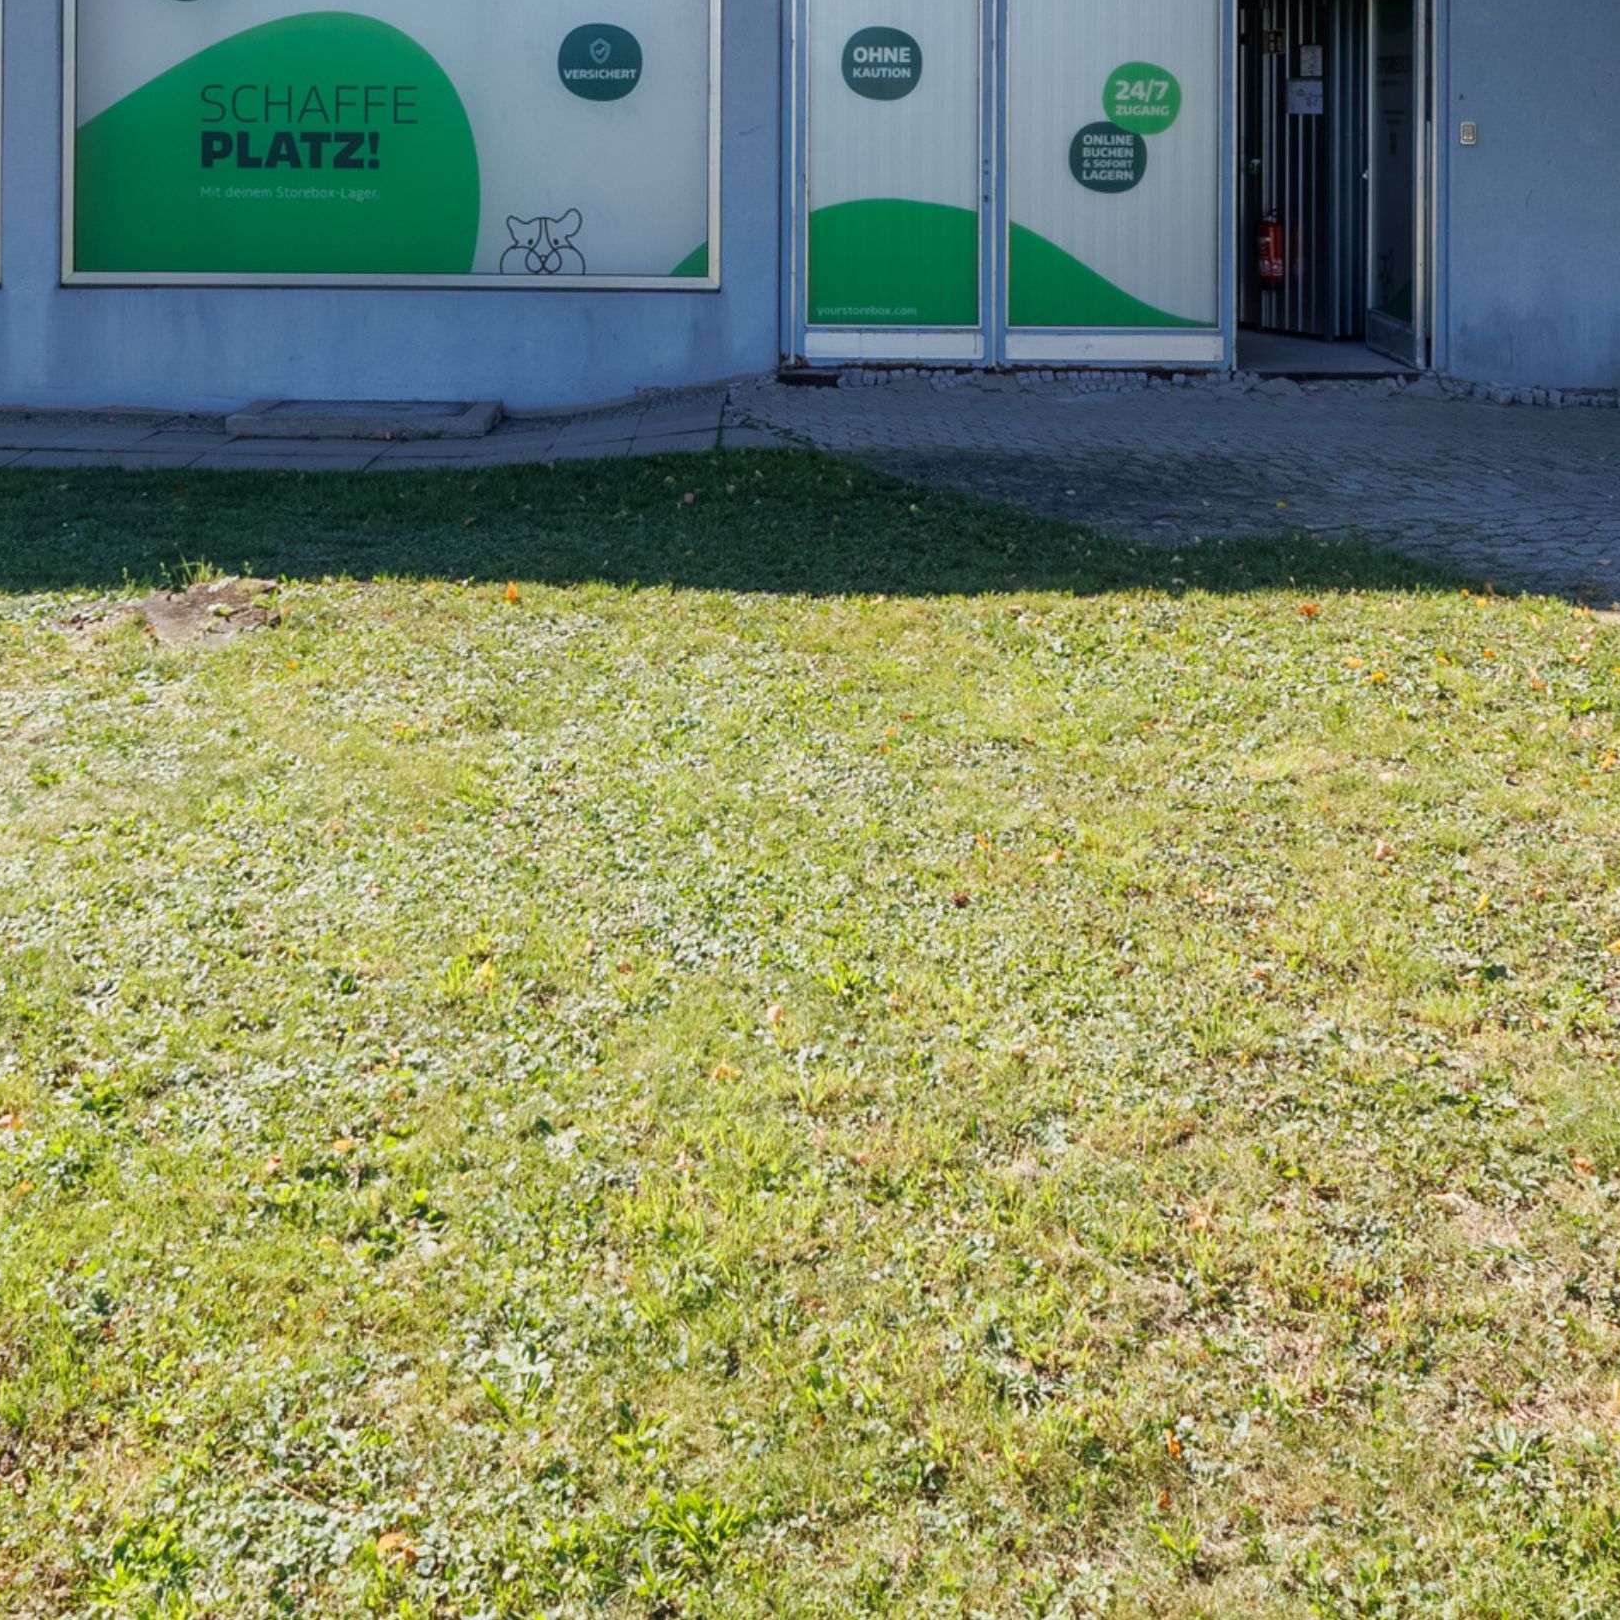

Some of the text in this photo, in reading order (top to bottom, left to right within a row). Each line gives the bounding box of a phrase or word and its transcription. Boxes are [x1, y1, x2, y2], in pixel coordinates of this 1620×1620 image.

[853, 47, 910, 62] OHNE
[564, 69, 637, 80] VERSICHERT
[853, 68, 910, 78] KAUTION
[1116, 79, 1168, 102] 24/7
[200, 85, 417, 124] SCHAFFE
[1115, 105, 1169, 116] ZUGANG
[1083, 135, 1133, 145] ONLINE
[201, 131, 379, 169] PLATZ!
[1083, 147, 1133, 158] BUCHEN
[1083, 159, 1133, 168] & SOFORT
[1083, 170, 1133, 180] LAGERN
[200, 186, 380, 202] Mit deinem Storebox-Lager.
[817, 306, 917, 316] yourstorebox.com
